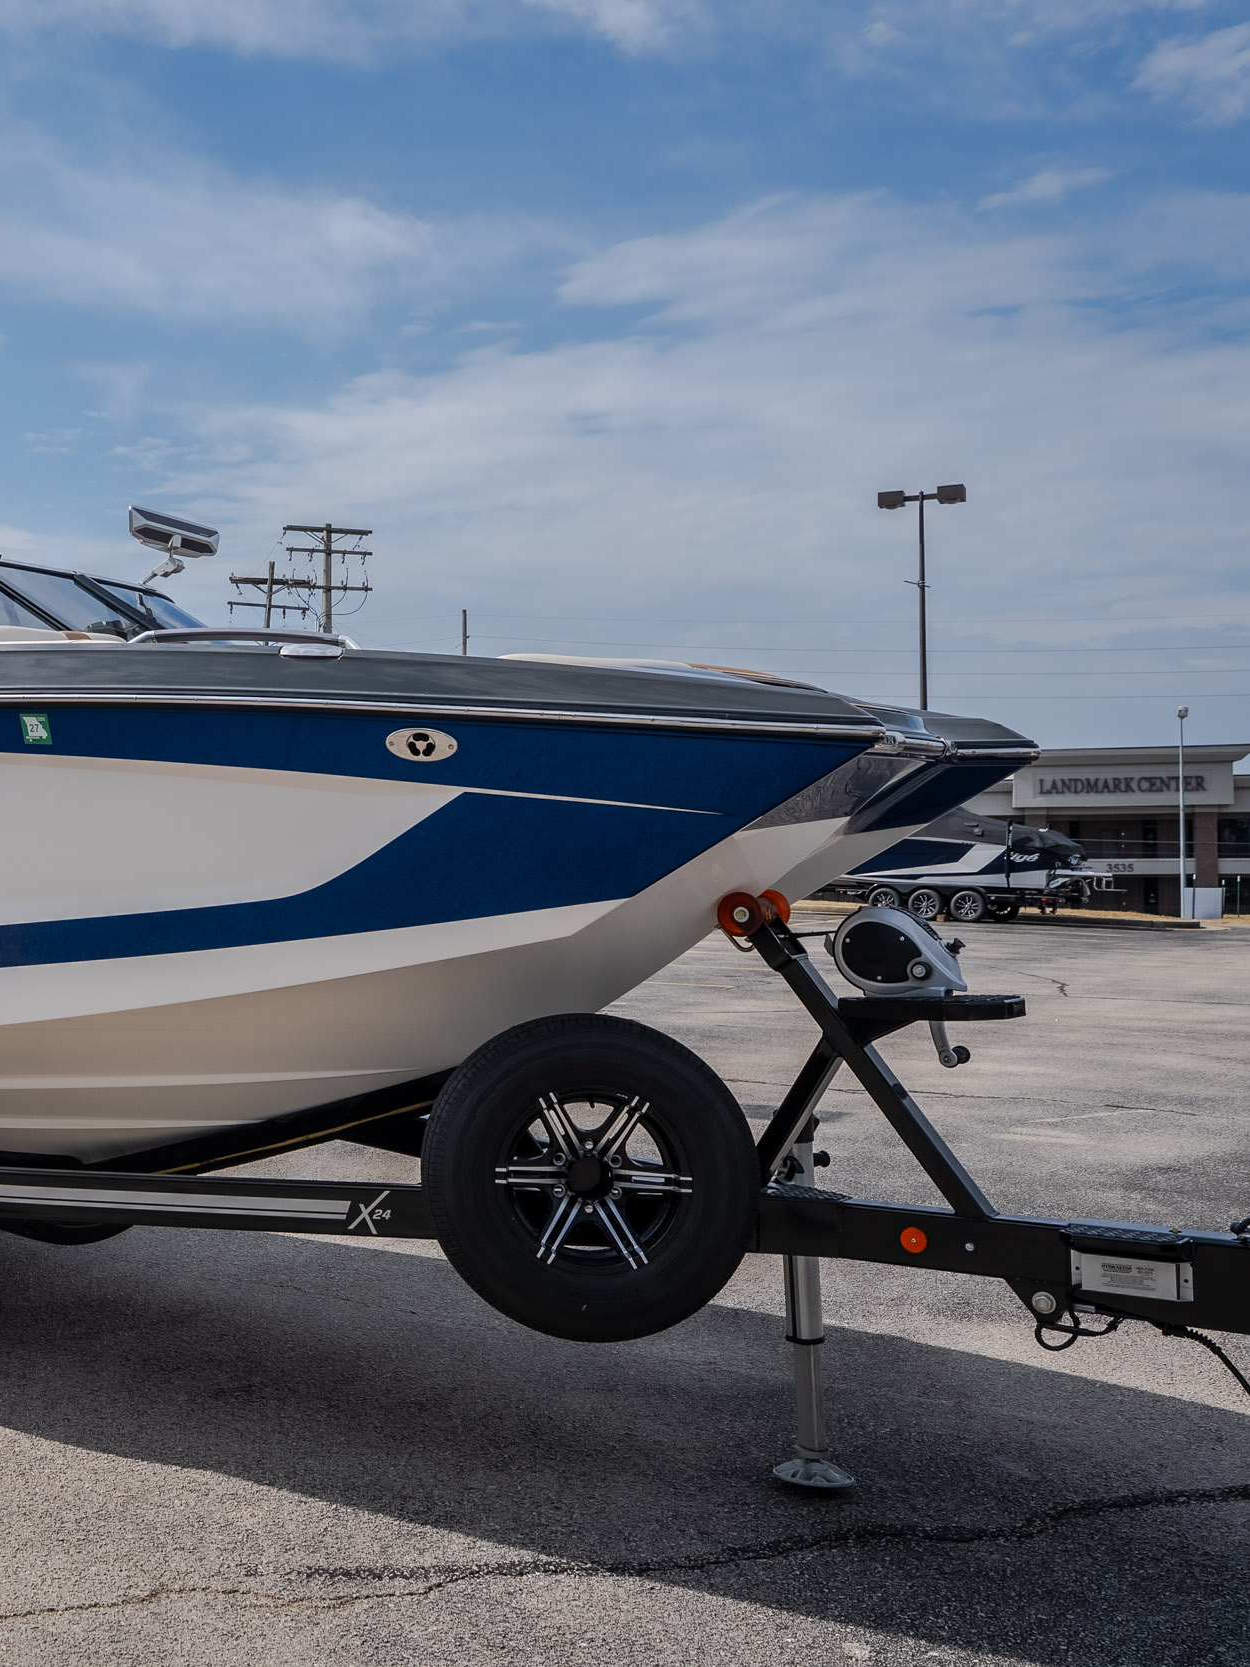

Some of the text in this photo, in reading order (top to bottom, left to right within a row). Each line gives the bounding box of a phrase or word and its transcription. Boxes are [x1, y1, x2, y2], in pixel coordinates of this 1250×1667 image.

[29, 723, 40, 732] 27
[1039, 775, 1207, 795] LANDMARK CENTER
[1106, 863, 1134, 873] 3535
